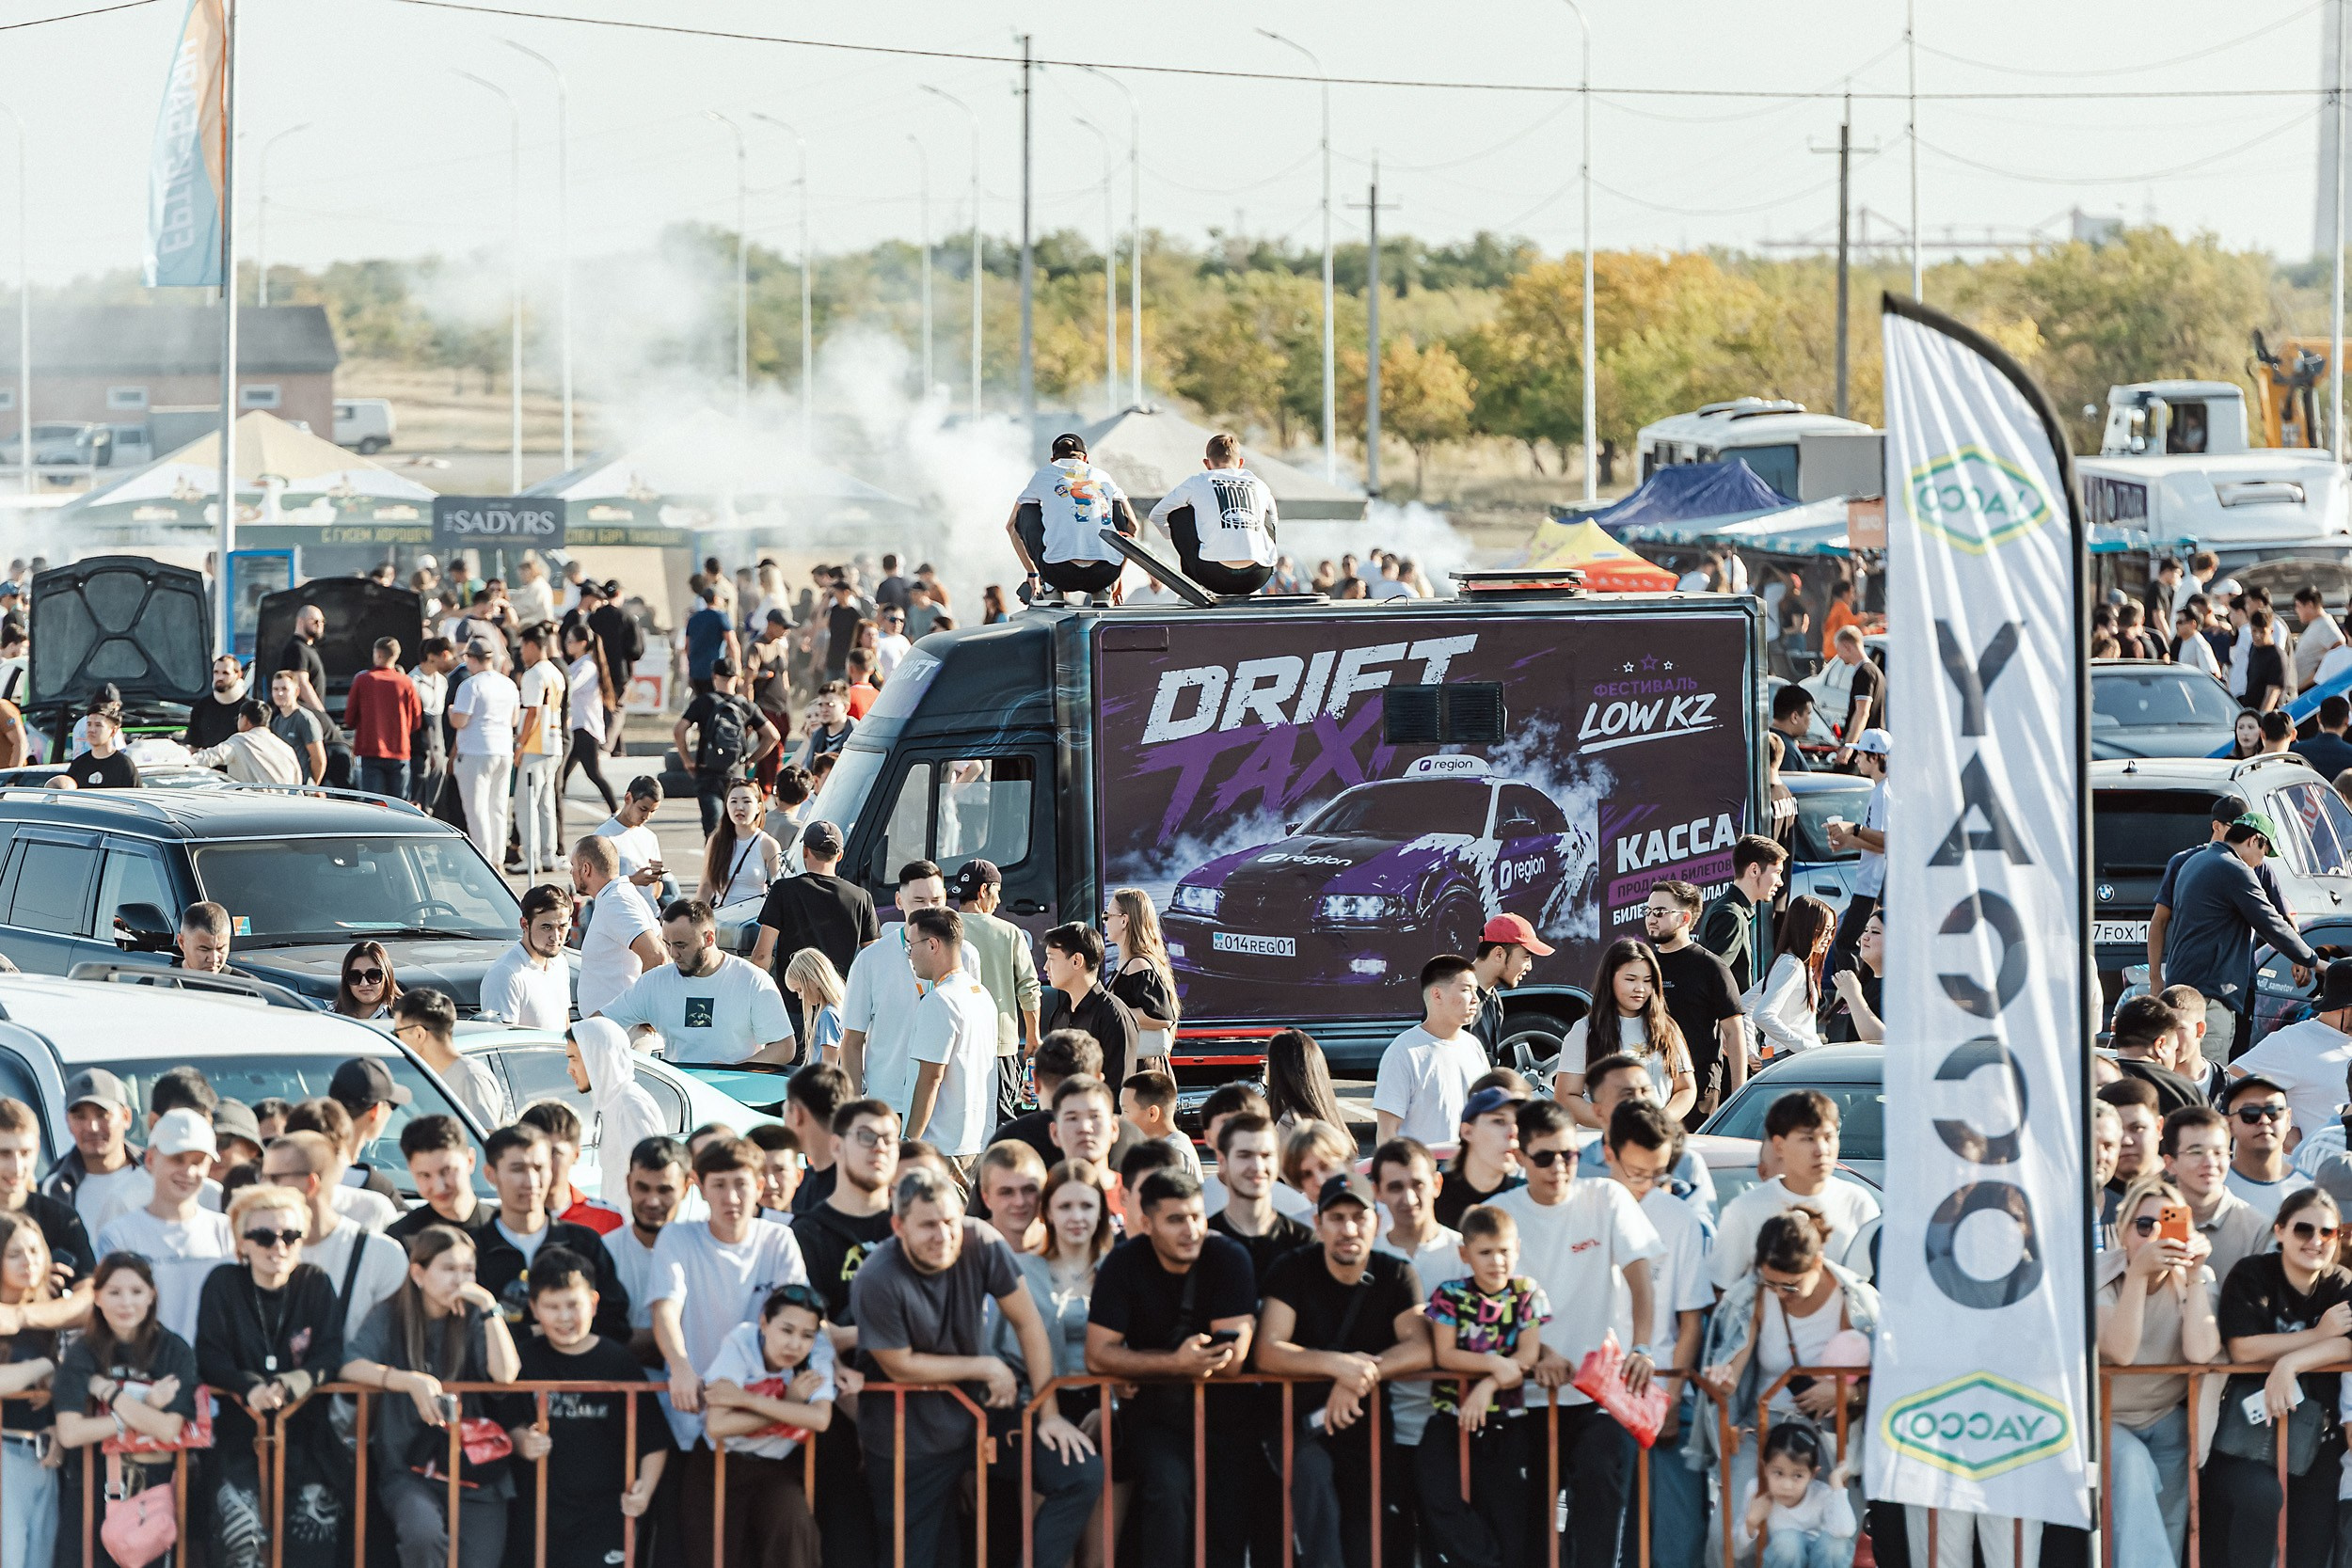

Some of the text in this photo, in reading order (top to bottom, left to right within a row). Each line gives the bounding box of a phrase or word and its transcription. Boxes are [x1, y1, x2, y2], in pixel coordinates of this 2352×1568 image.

[454, 510, 556, 534] SADYRS
[1141, 634, 1479, 744] DRIFT
[1594, 676, 1698, 698] ФЕСТИВАЛЬ
[1578, 693, 1718, 742] LOW KZ
[1434, 758, 1473, 771] region
[1616, 813, 1738, 874] КАССА
[1285, 854, 1353, 866] region
[1514, 855, 1546, 883] region
[1681, 858, 1732, 882] БИЛЕТОВ
[1277, 940, 1295, 955] 01
